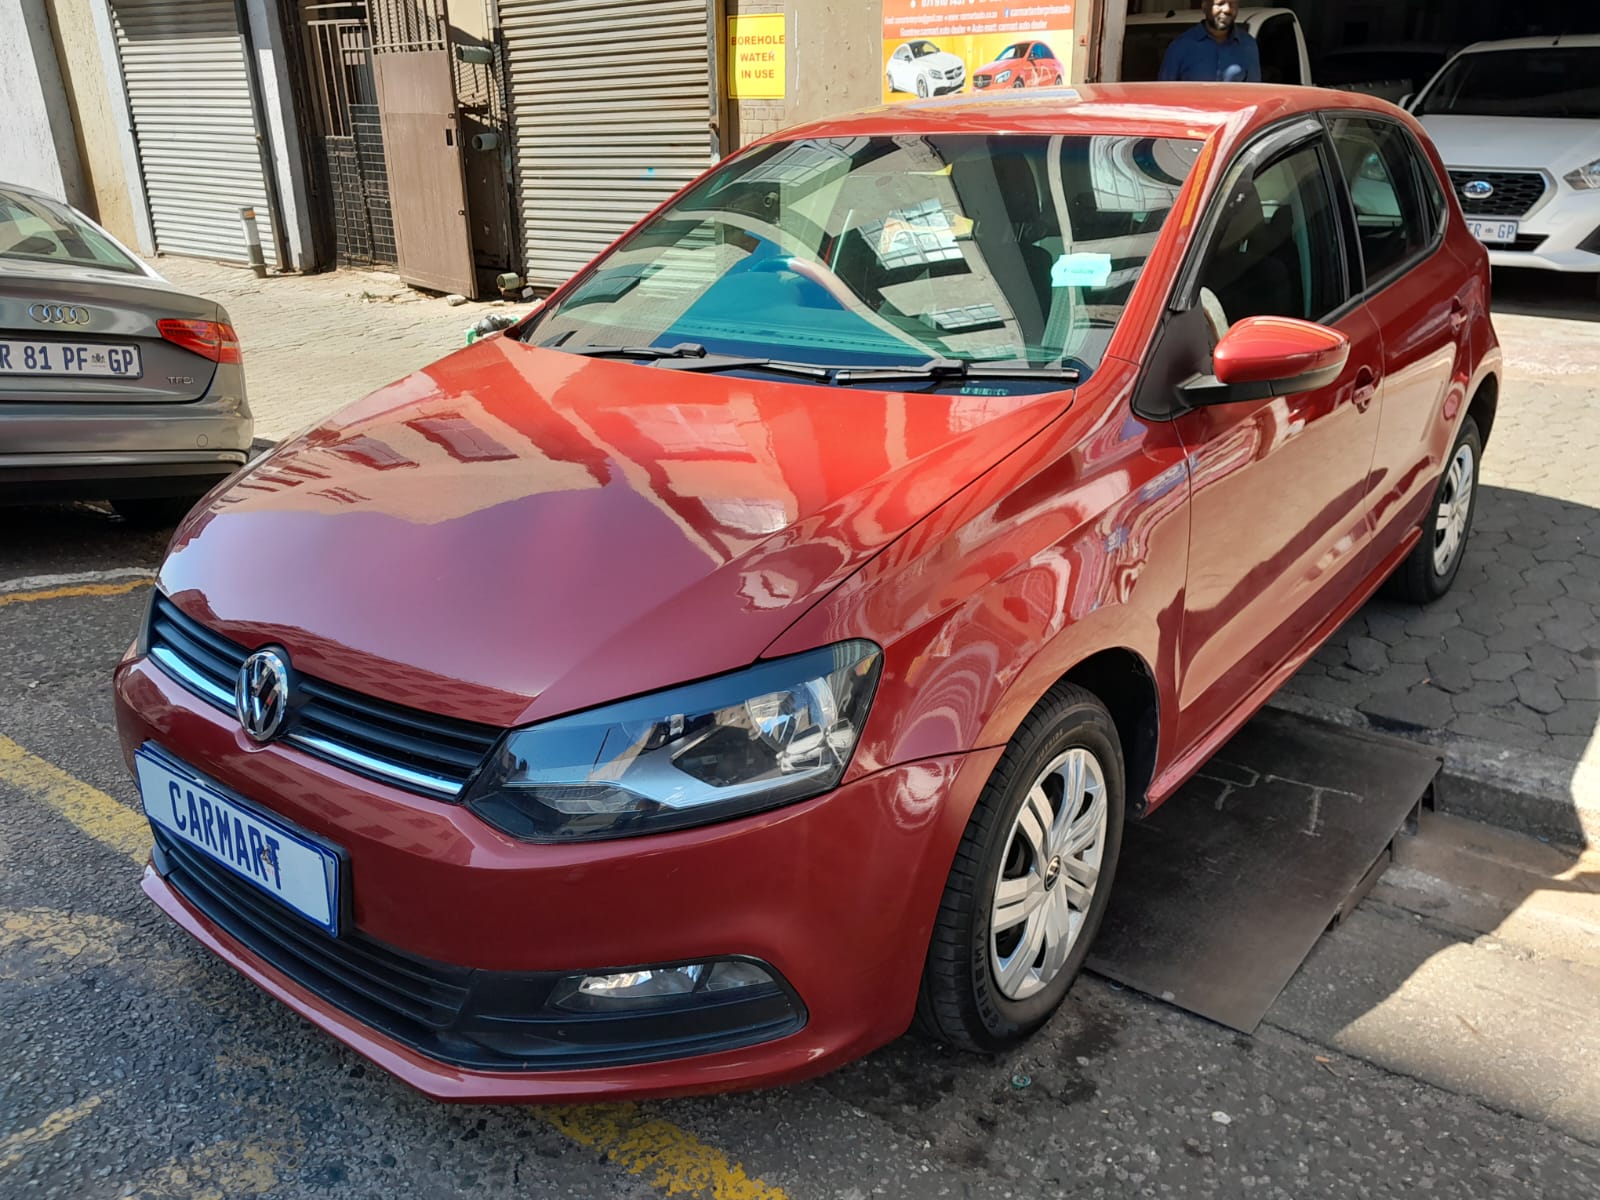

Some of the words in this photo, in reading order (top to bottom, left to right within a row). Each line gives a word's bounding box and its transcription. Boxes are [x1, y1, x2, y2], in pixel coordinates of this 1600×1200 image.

[731, 34, 785, 46] BOREHOLE
[740, 51, 775, 62] WATER
[741, 69, 751, 79] IN
[754, 69, 775, 79] USE
[1497, 223, 1515, 239] GP
[24, 345, 52, 370] 81
[62, 346, 88, 371] PF
[108, 348, 133, 373] GP
[168, 780, 282, 890] CARMART
